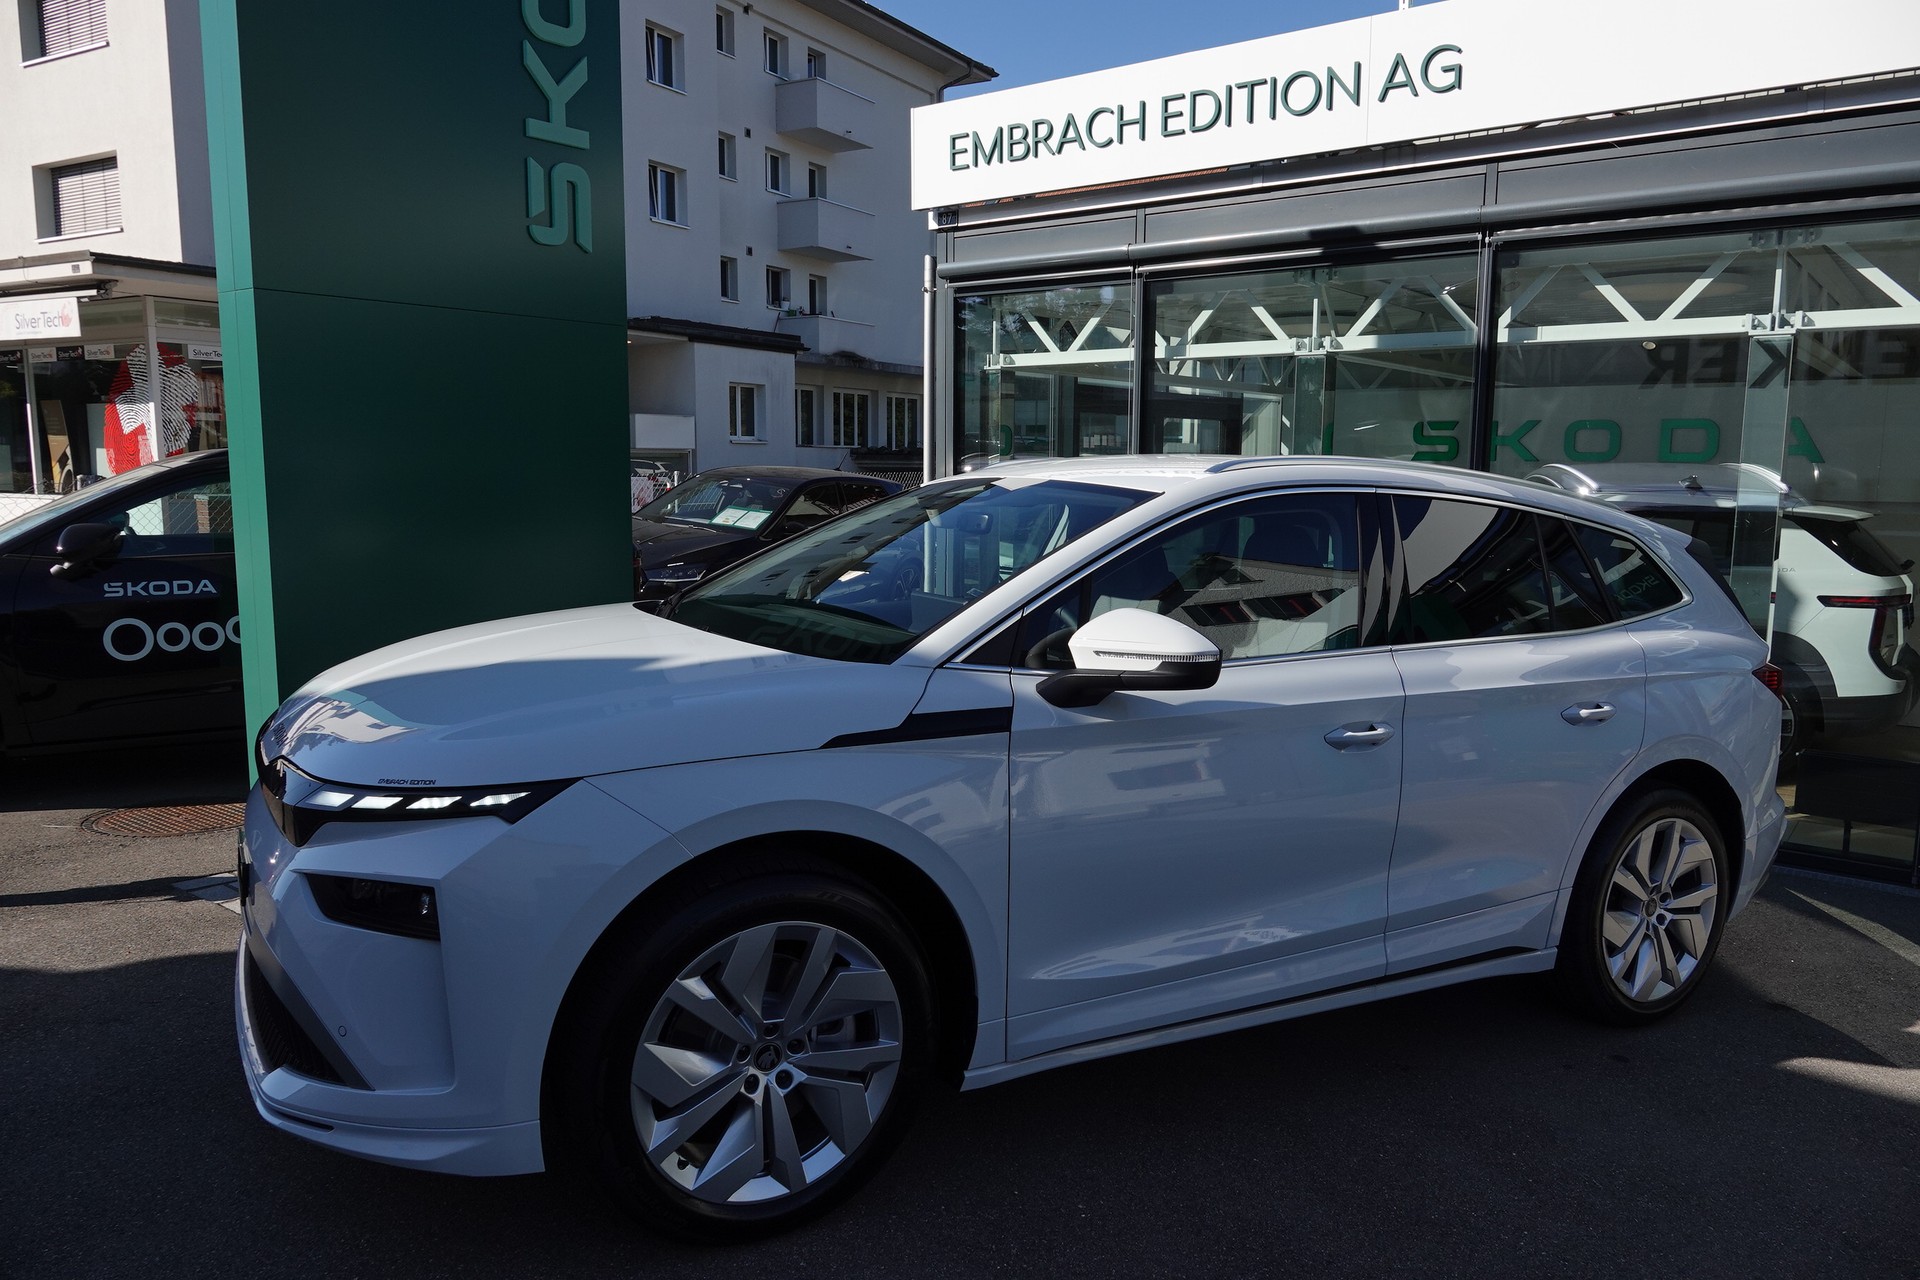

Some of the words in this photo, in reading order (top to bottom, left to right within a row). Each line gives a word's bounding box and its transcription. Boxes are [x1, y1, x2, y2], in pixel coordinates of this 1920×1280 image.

[950, 99, 1146, 171] EMBRACH
[1160, 61, 1361, 137] EDITION
[1378, 44, 1463, 102] AG
[103, 579, 218, 598] SKODA
